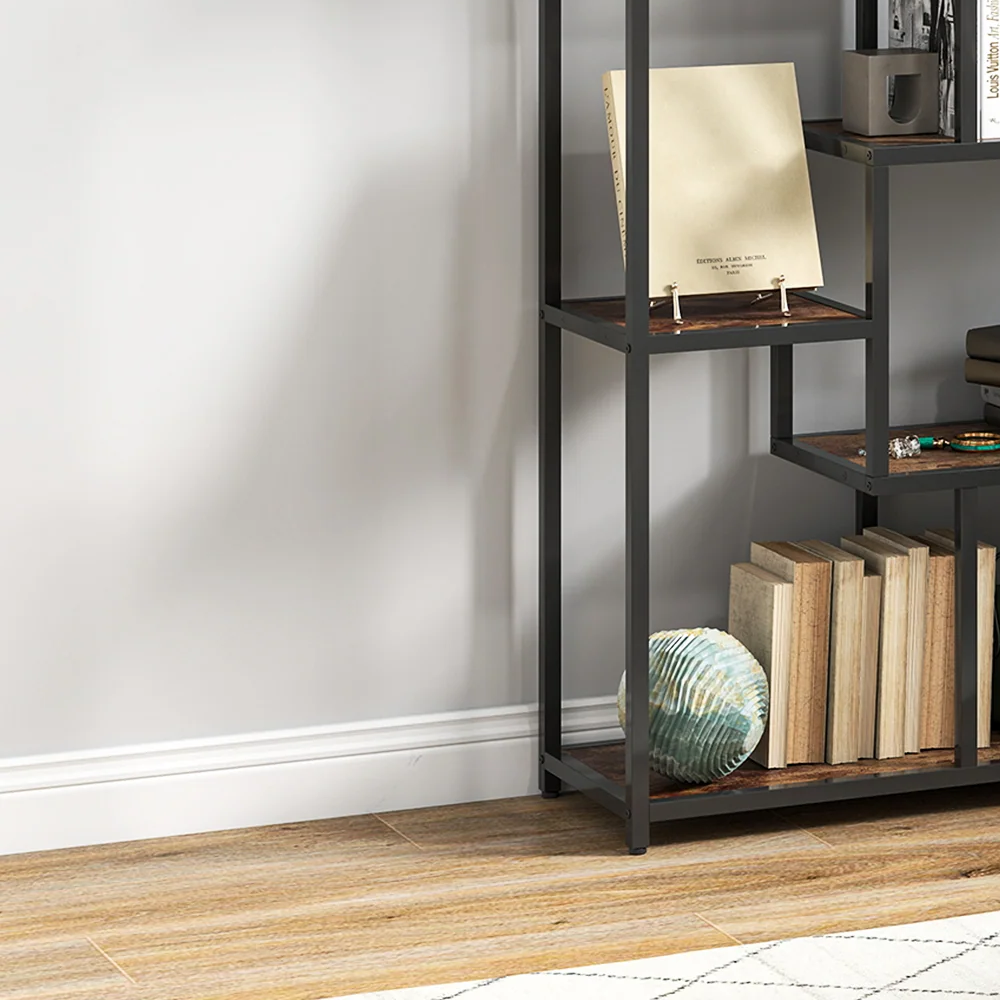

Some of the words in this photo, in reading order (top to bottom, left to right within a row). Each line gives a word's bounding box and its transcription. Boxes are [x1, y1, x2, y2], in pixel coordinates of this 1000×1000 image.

[986, 24, 1000, 40] Art,
[986, 42, 999, 74] Vuitton
[986, 74, 999, 99] Louis
